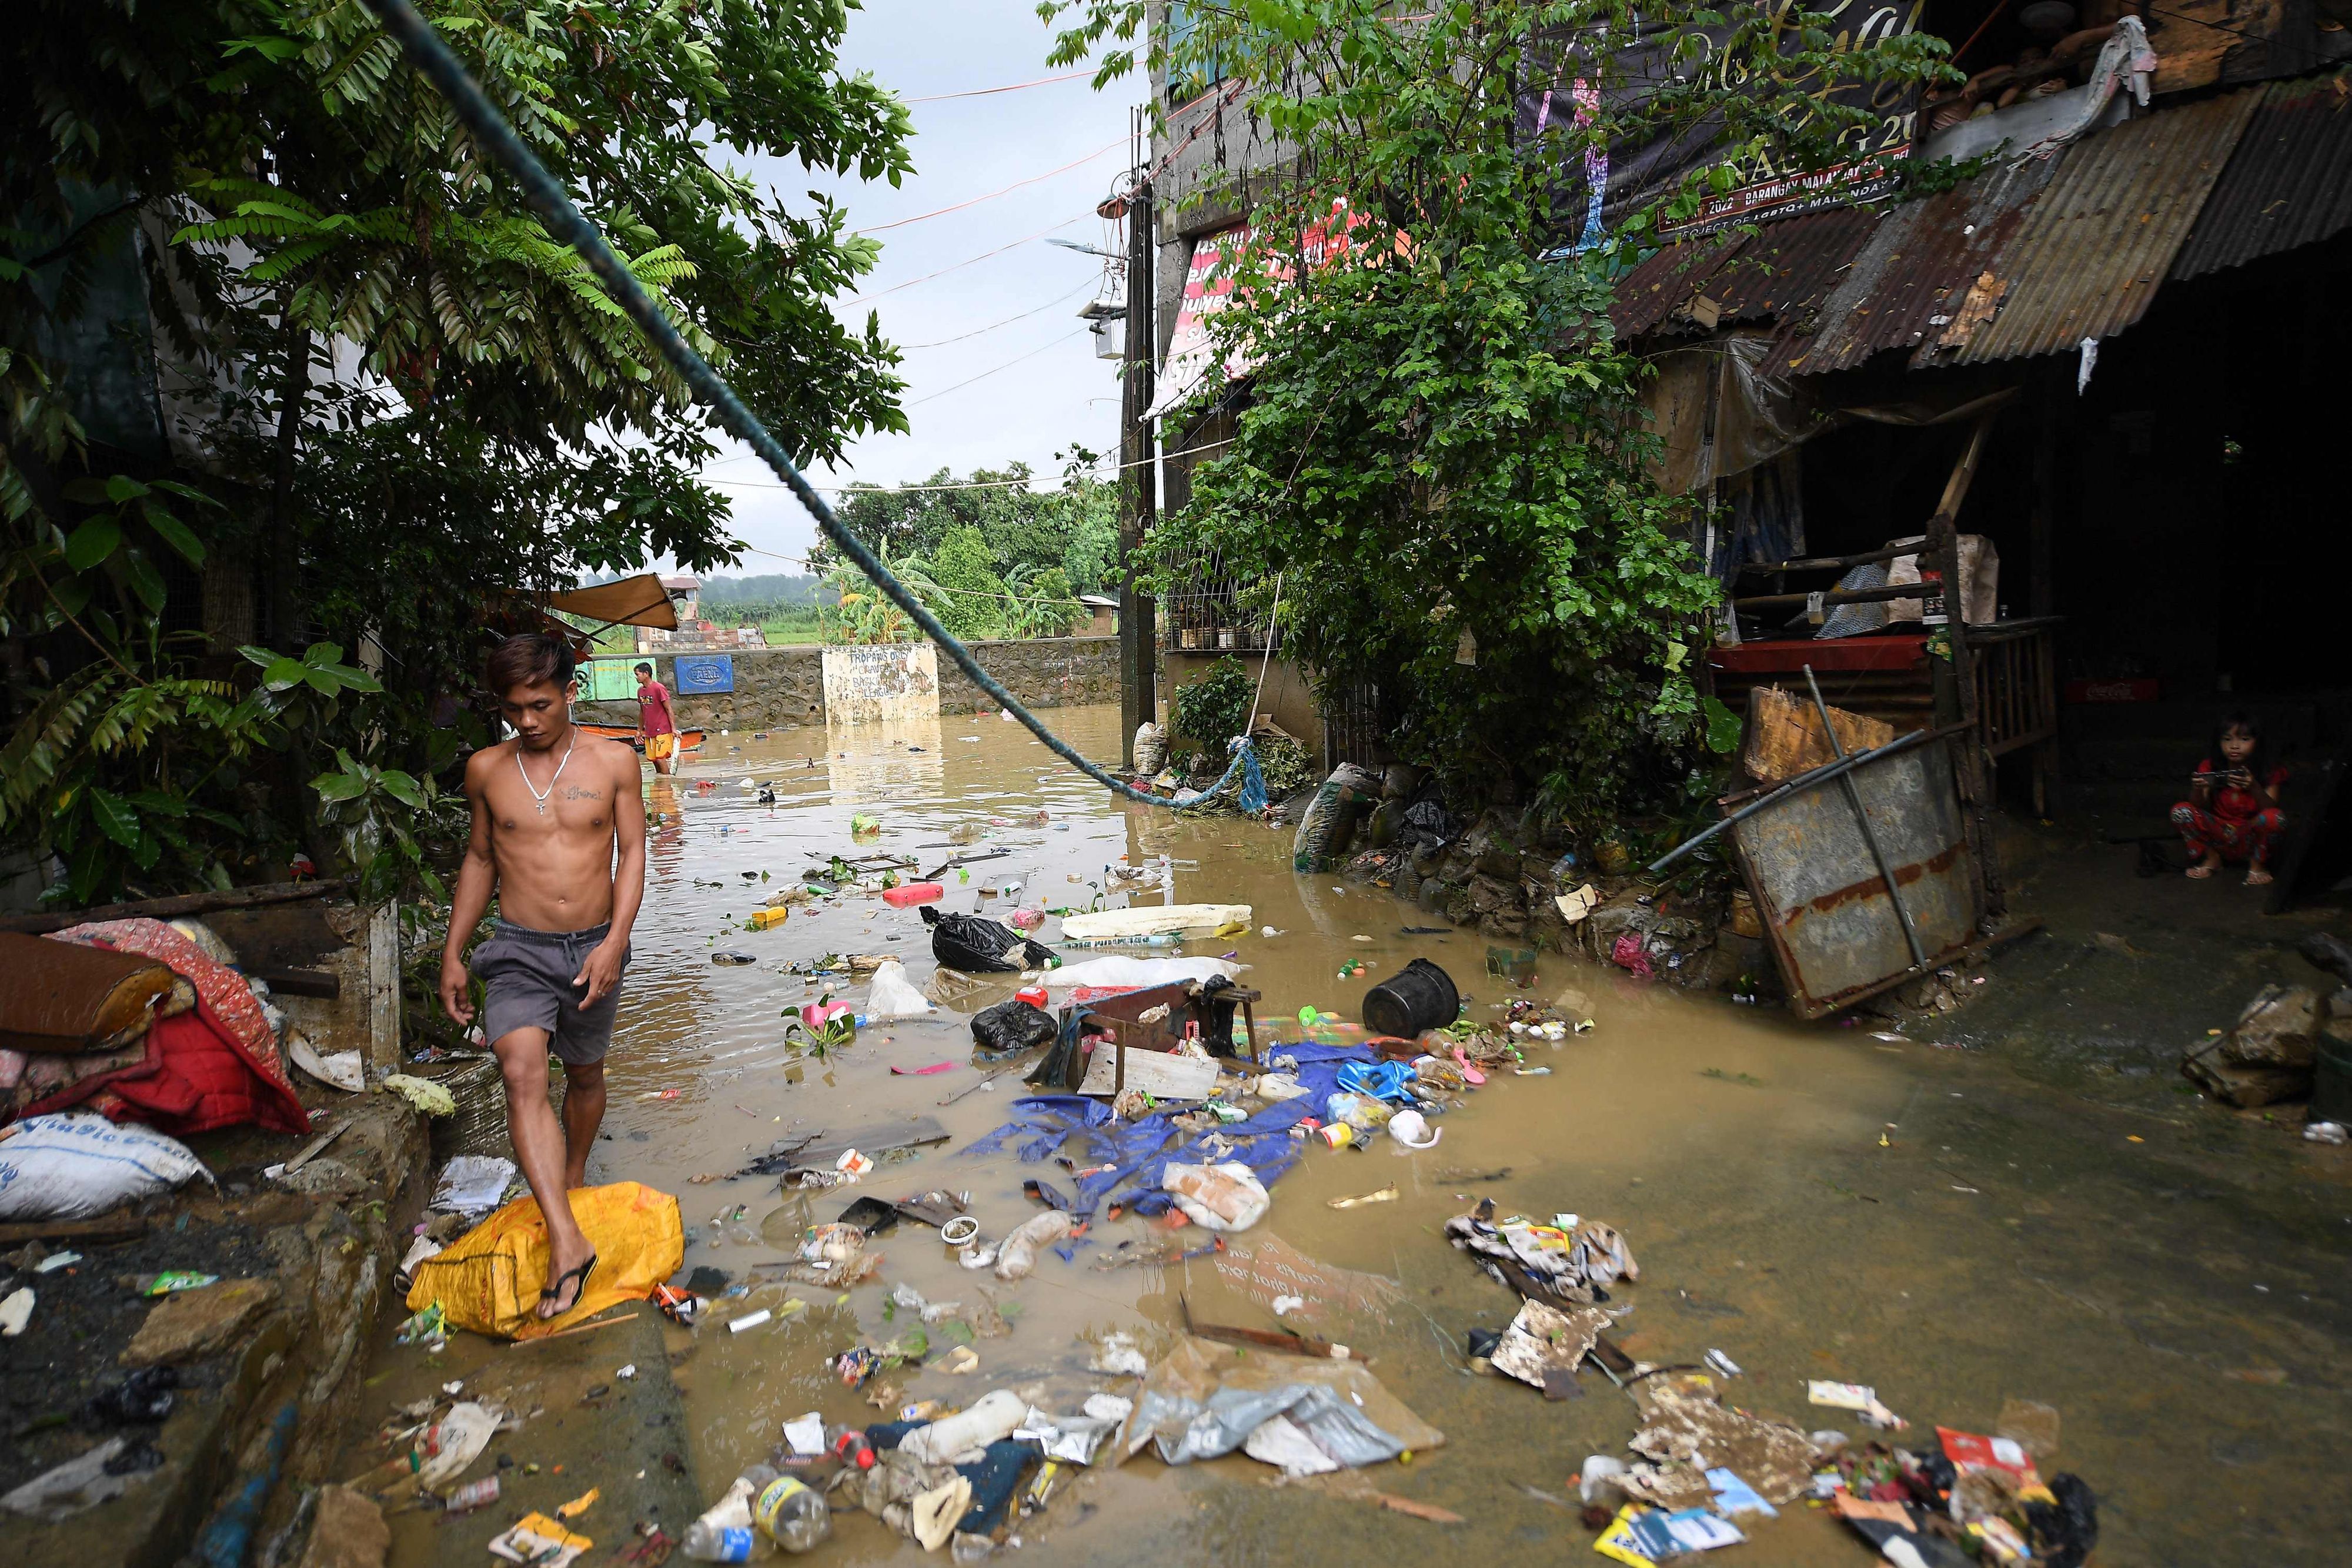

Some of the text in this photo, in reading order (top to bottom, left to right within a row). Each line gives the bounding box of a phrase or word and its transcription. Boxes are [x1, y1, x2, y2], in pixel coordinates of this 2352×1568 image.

[1709, 196, 1734, 215] 2022
[1745, 179, 1799, 206] BARANGAY
[1732, 216, 1749, 226] OF
[1753, 203, 1805, 221] LGBTQ+
[847, 652, 888, 663] TROPANG
